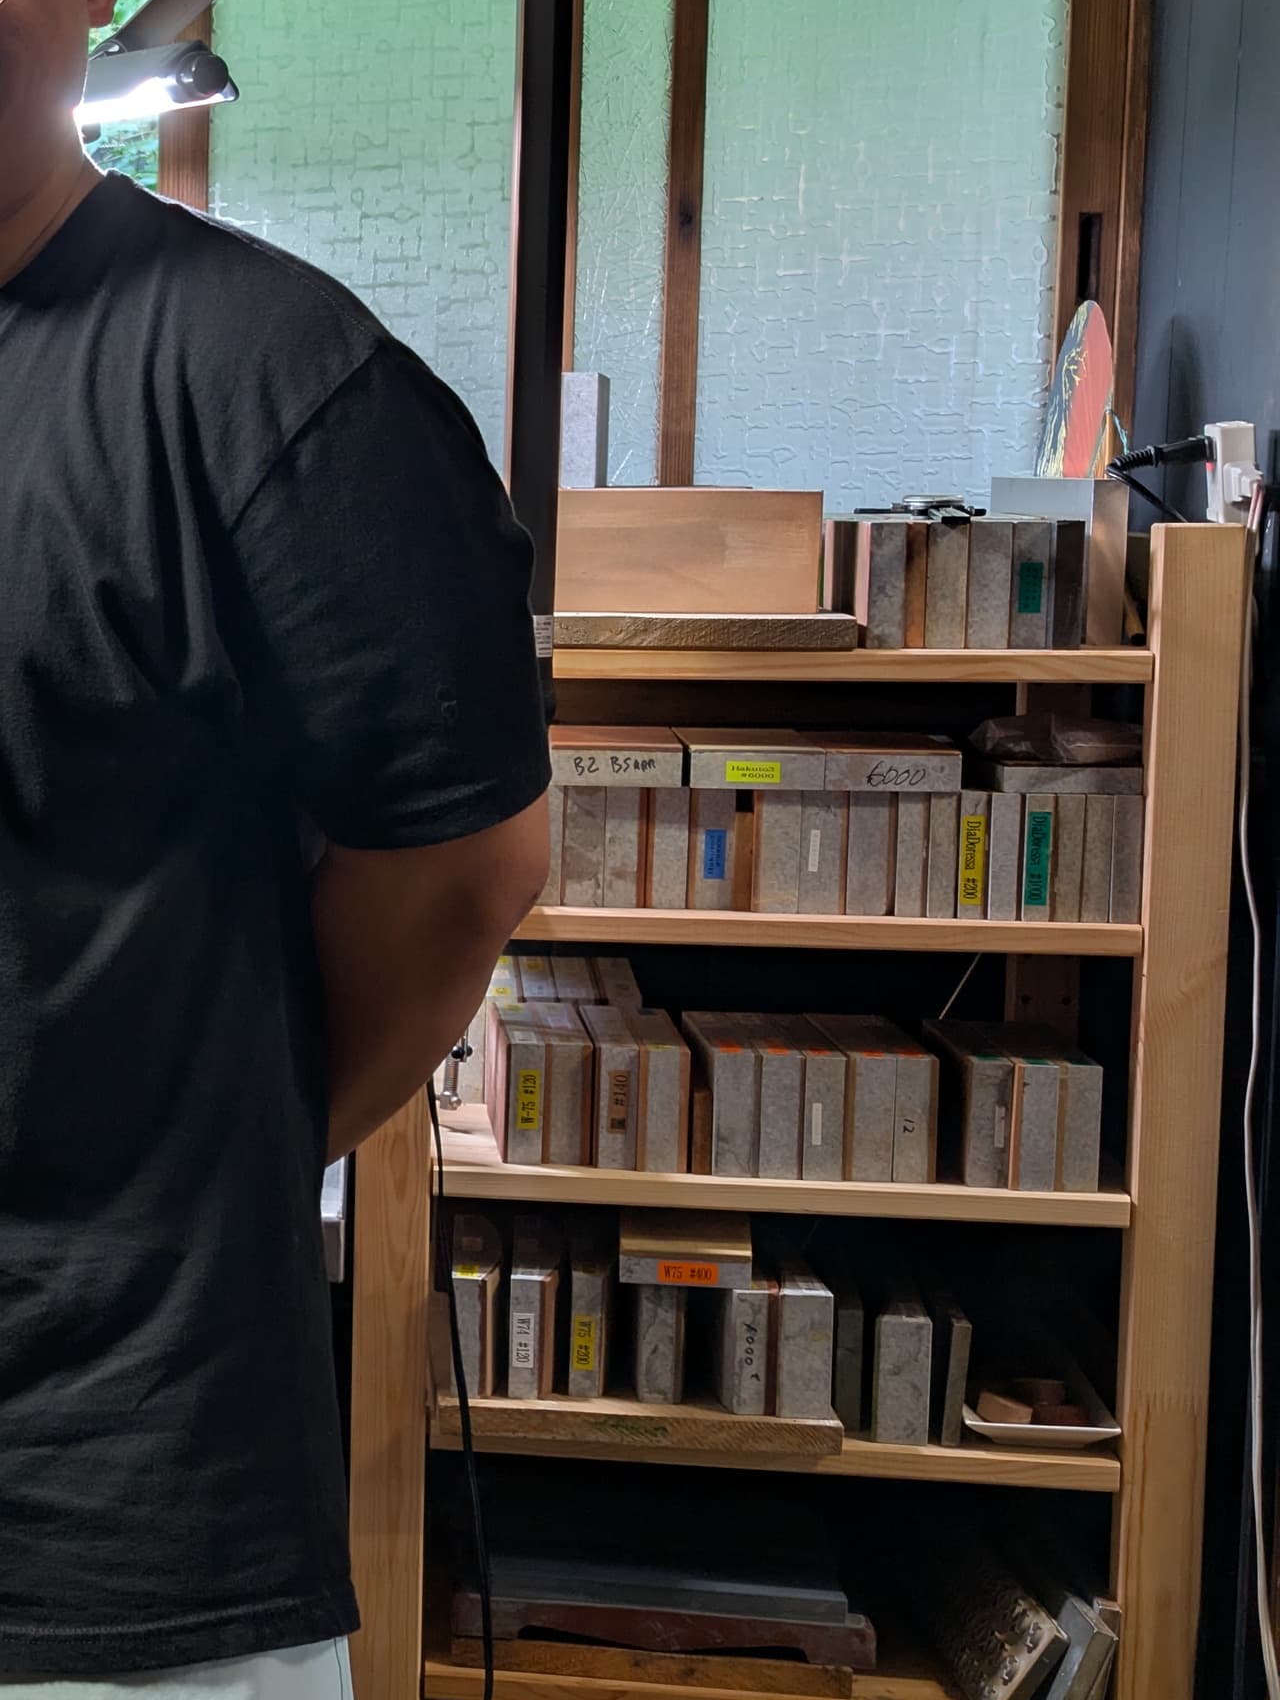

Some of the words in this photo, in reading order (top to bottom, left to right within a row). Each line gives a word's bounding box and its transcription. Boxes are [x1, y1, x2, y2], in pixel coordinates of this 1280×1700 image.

[573, 755, 599, 776] B2
[963, 878, 978, 900] #200
[523, 1074, 537, 1095] #120
[664, 1265, 683, 1279] W75
[516, 1317, 530, 1336] W74
[516, 1342, 530, 1363] #120
